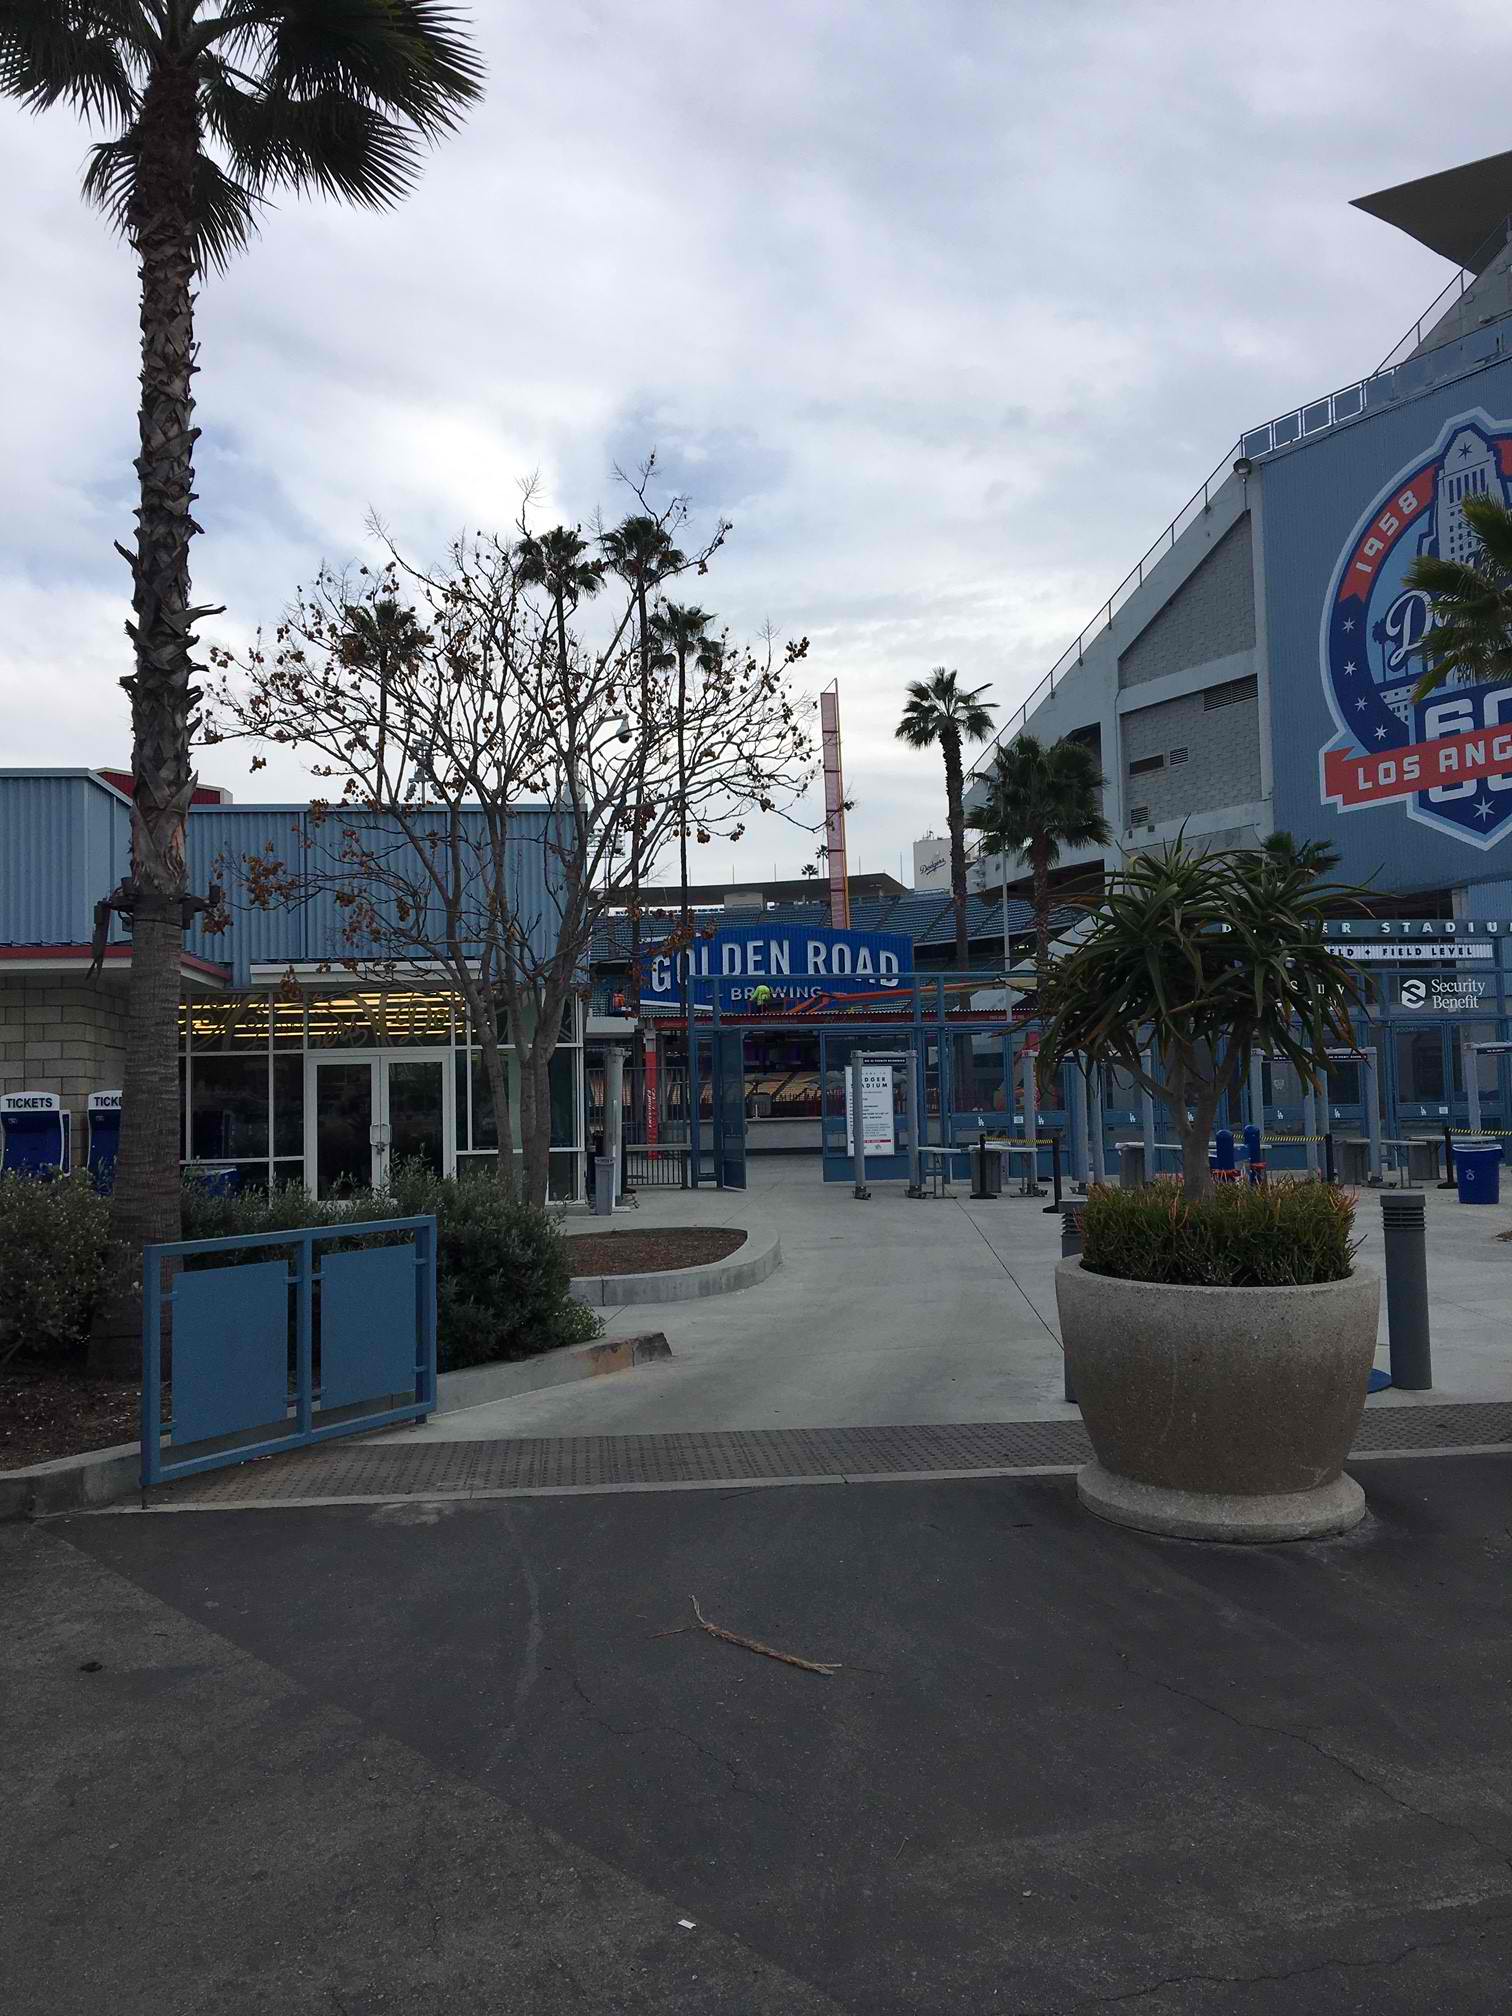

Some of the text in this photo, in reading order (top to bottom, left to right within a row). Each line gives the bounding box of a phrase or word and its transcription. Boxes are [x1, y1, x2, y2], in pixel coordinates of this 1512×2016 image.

[1356, 490, 1418, 573] 1958
[1358, 755, 1420, 790] LOS
[1381, 921, 1512, 934] STADIU
[1382, 948, 1422, 957] FIELD
[1431, 946, 1473, 956] LEVEL
[651, 939, 900, 993] GOLDEN ROAD
[730, 984, 823, 1001] BRWING
[1430, 978, 1486, 994] Security
[1432, 995, 1480, 1009] Benefit
[6, 1097, 54, 1109] TICKETS
